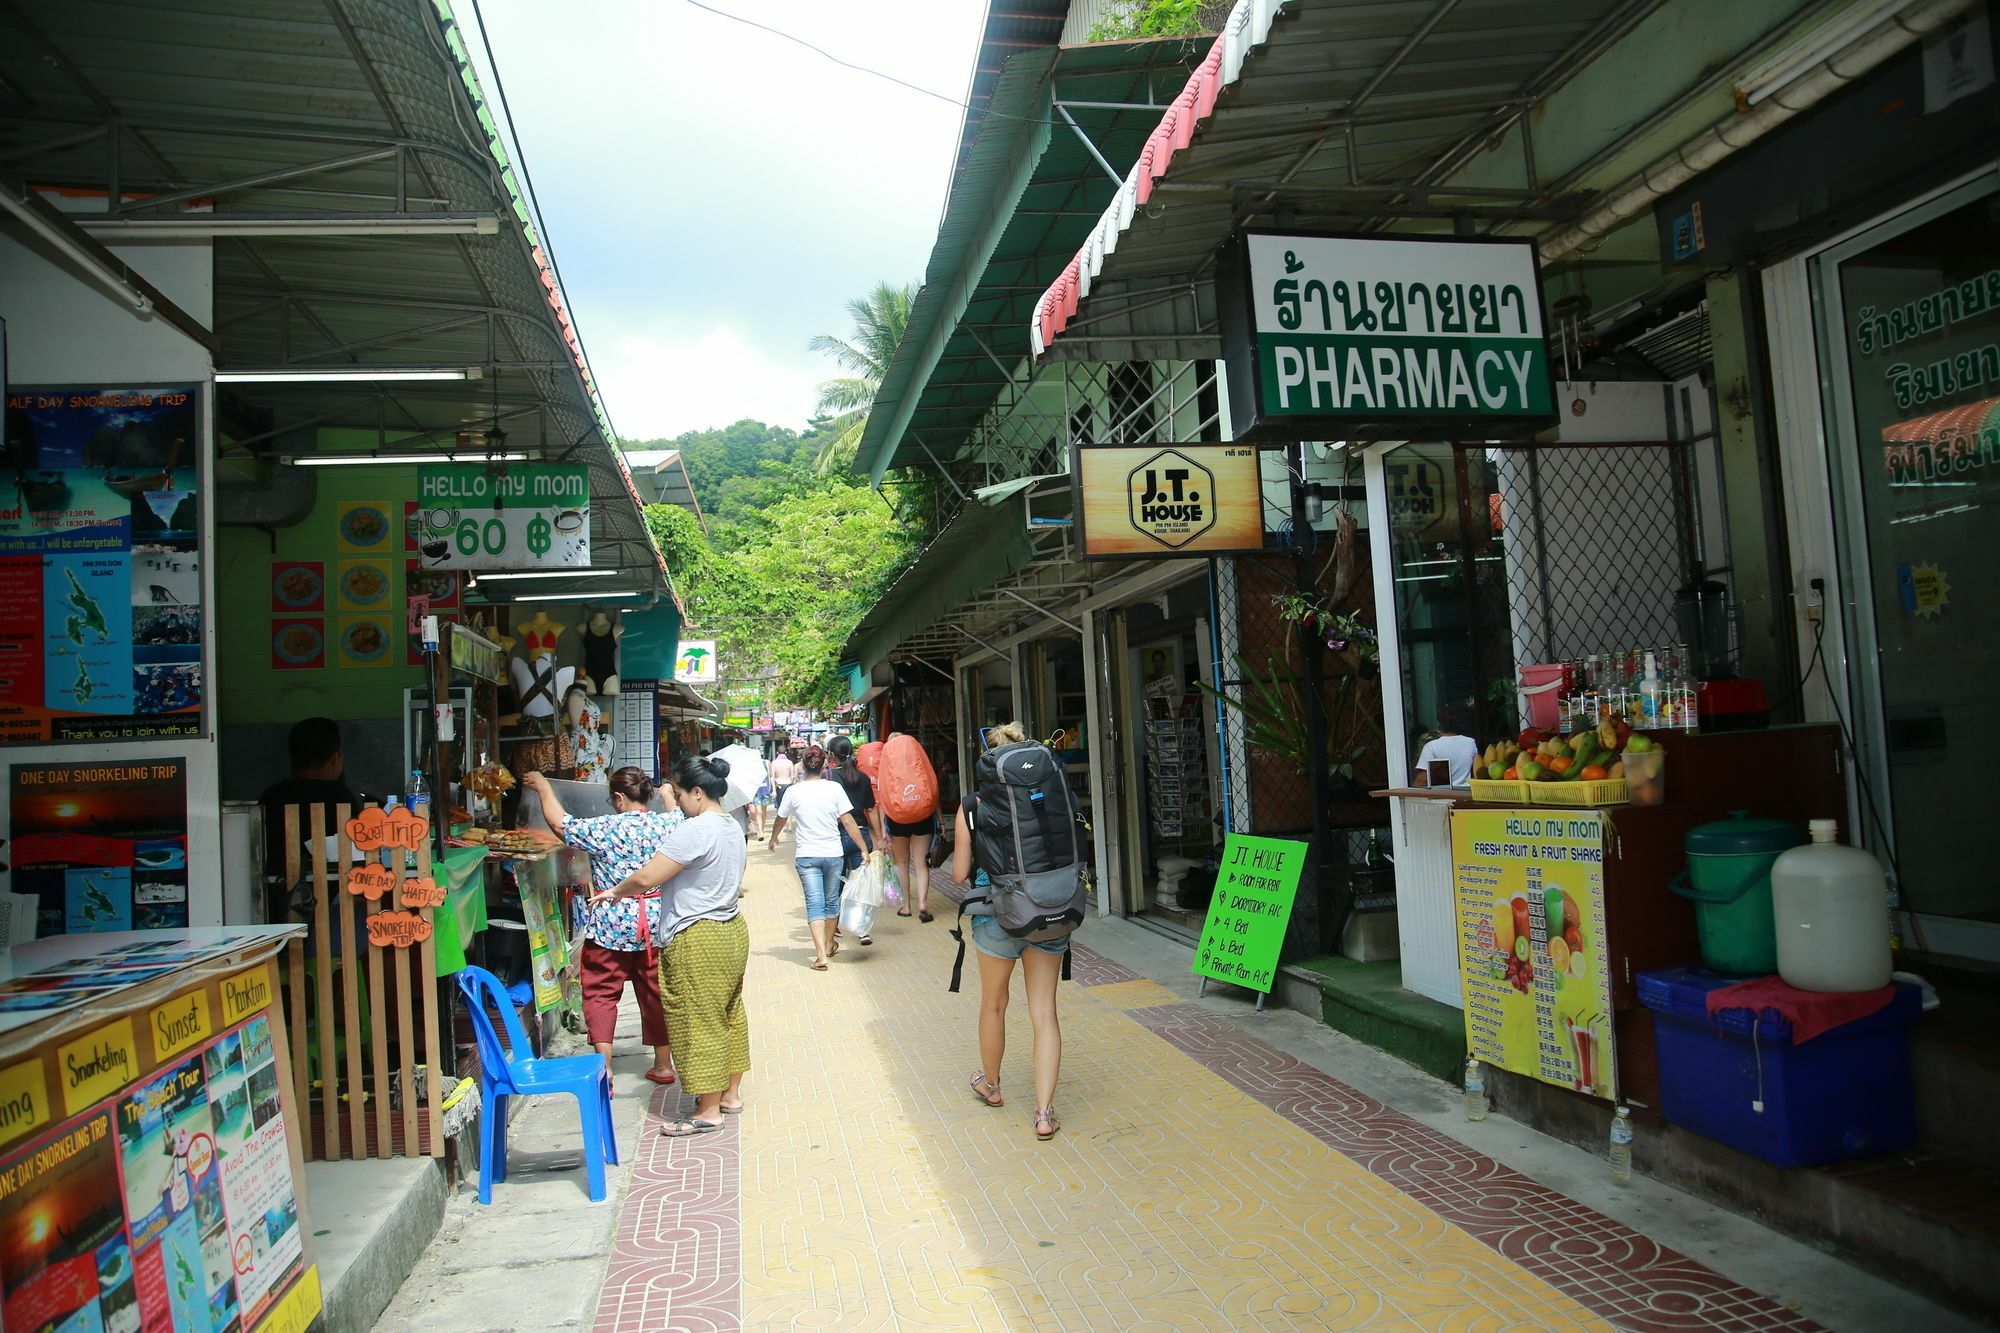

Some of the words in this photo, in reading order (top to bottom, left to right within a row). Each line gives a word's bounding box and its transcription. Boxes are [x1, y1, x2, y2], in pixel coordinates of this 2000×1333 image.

[1272, 250, 1528, 334] ร้านขายยา
[1274, 346, 1532, 410] PHARMACY
[38, 397, 64, 408] DAY
[70, 395, 152, 408] SNORKELING
[159, 394, 188, 406] TRIP
[423, 476, 487, 496] HELLO
[1141, 468, 1200, 505] J.T.
[1142, 504, 1202, 522] HOUSE
[62, 538, 72, 548] be
[456, 518, 506, 556] 60
[61, 729, 94, 740] Thank
[100, 729, 120, 739] you
[122, 728, 132, 737] to
[160, 726, 181, 736] with
[184, 726, 198, 735] us
[20, 772, 44, 784] ONE
[48, 770, 70, 784] DAY
[74, 767, 148, 782] SNORKELING
[152, 766, 178, 780] TRIP
[354, 819, 384, 842] Boat
[384, 821, 422, 848] Trip
[1506, 819, 1541, 836] HELLO
[1252, 849, 1286, 872] HOUSE
[1474, 842, 1500, 856] FRESH
[1504, 844, 1528, 858] FRUIT
[1532, 844, 1538, 858] &
[1542, 846, 1567, 860] FRUIT
[1570, 848, 1602, 862] SHAKE
[355, 872, 376, 886] ONE
[377, 876, 395, 888] DAY
[1239, 873, 1255, 888] ROOM
[1256, 877, 1267, 890] FOR
[1267, 879, 1282, 892] RENT
[1224, 917, 1230, 930] 4
[1234, 918, 1250, 934] Bed
[1228, 940, 1246, 956] Bed
[1211, 957, 1235, 976] Private
[1236, 962, 1250, 980] Room
[1254, 969, 1270, 986] A/C
[227, 980, 268, 1018] Plankton
[159, 1003, 200, 1052] Sunset
[68, 1041, 129, 1088] Snorkeling
[124, 1101, 146, 1124] The
[148, 1079, 177, 1110] Beach
[178, 1068, 200, 1090] Tour
[0, 1092, 34, 1128] ing
[18, 1158, 34, 1186] DAY
[35, 1130, 90, 1178] SNORKELING
[89, 1115, 108, 1140] TRIP
[224, 1151, 244, 1176] Avoid
[245, 1141, 259, 1158] The
[260, 1120, 283, 1145] Crowds
